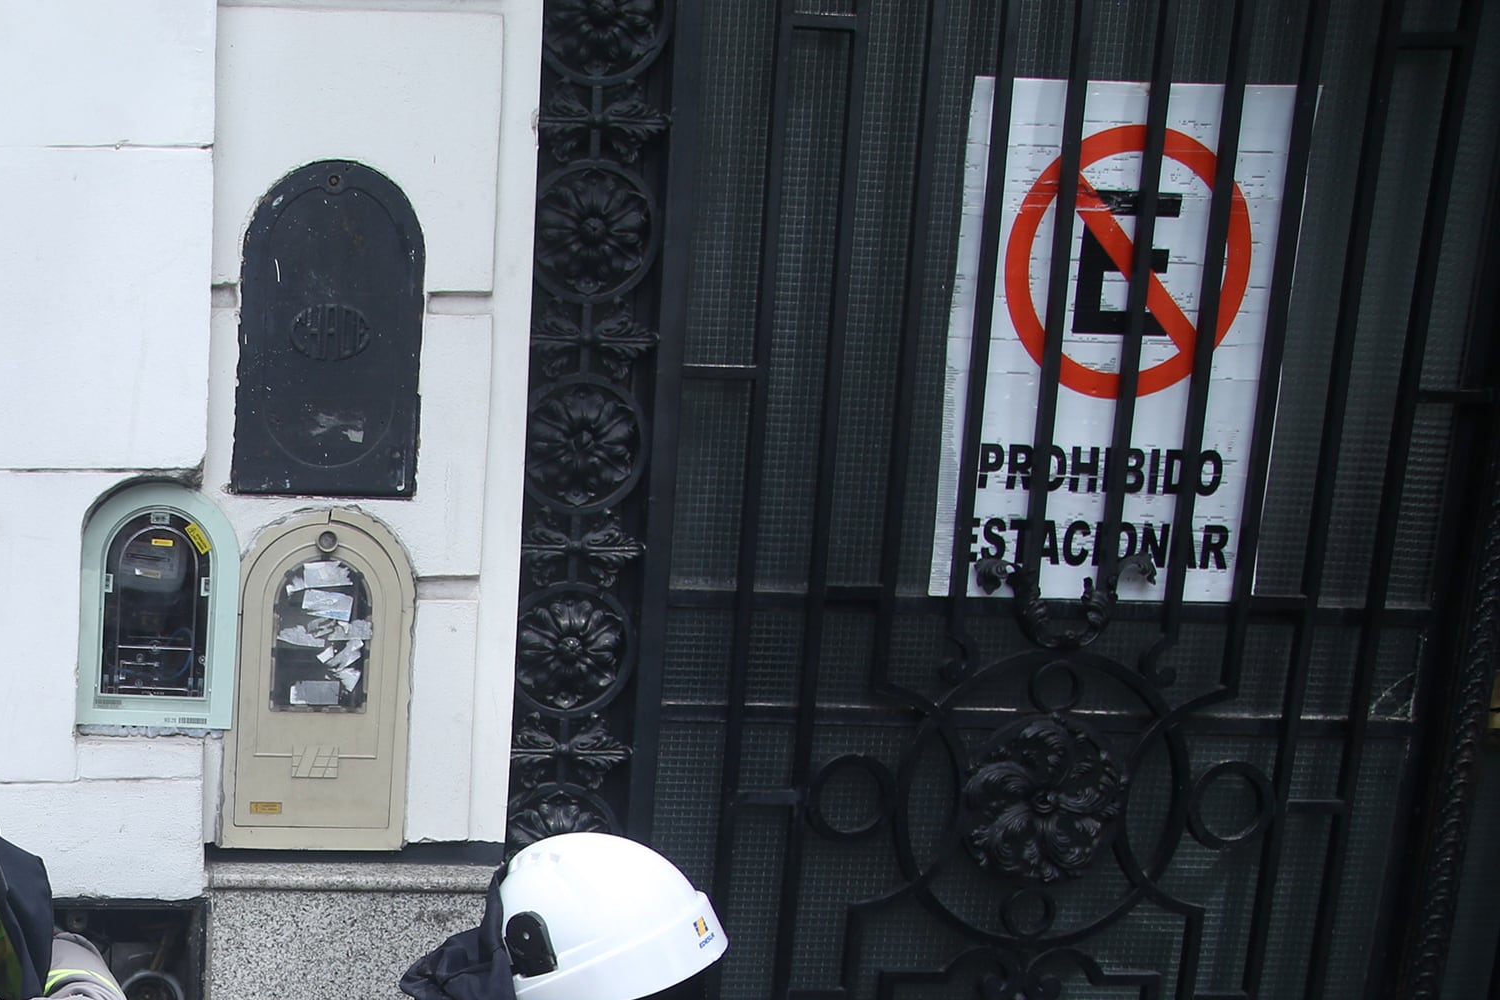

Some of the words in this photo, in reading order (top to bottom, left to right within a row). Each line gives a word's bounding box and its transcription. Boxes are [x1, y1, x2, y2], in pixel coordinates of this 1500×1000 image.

[1072, 190, 1183, 336] E
[977, 443, 1223, 496] PROHIBIDO
[967, 517, 1229, 570] ESTACIONR
